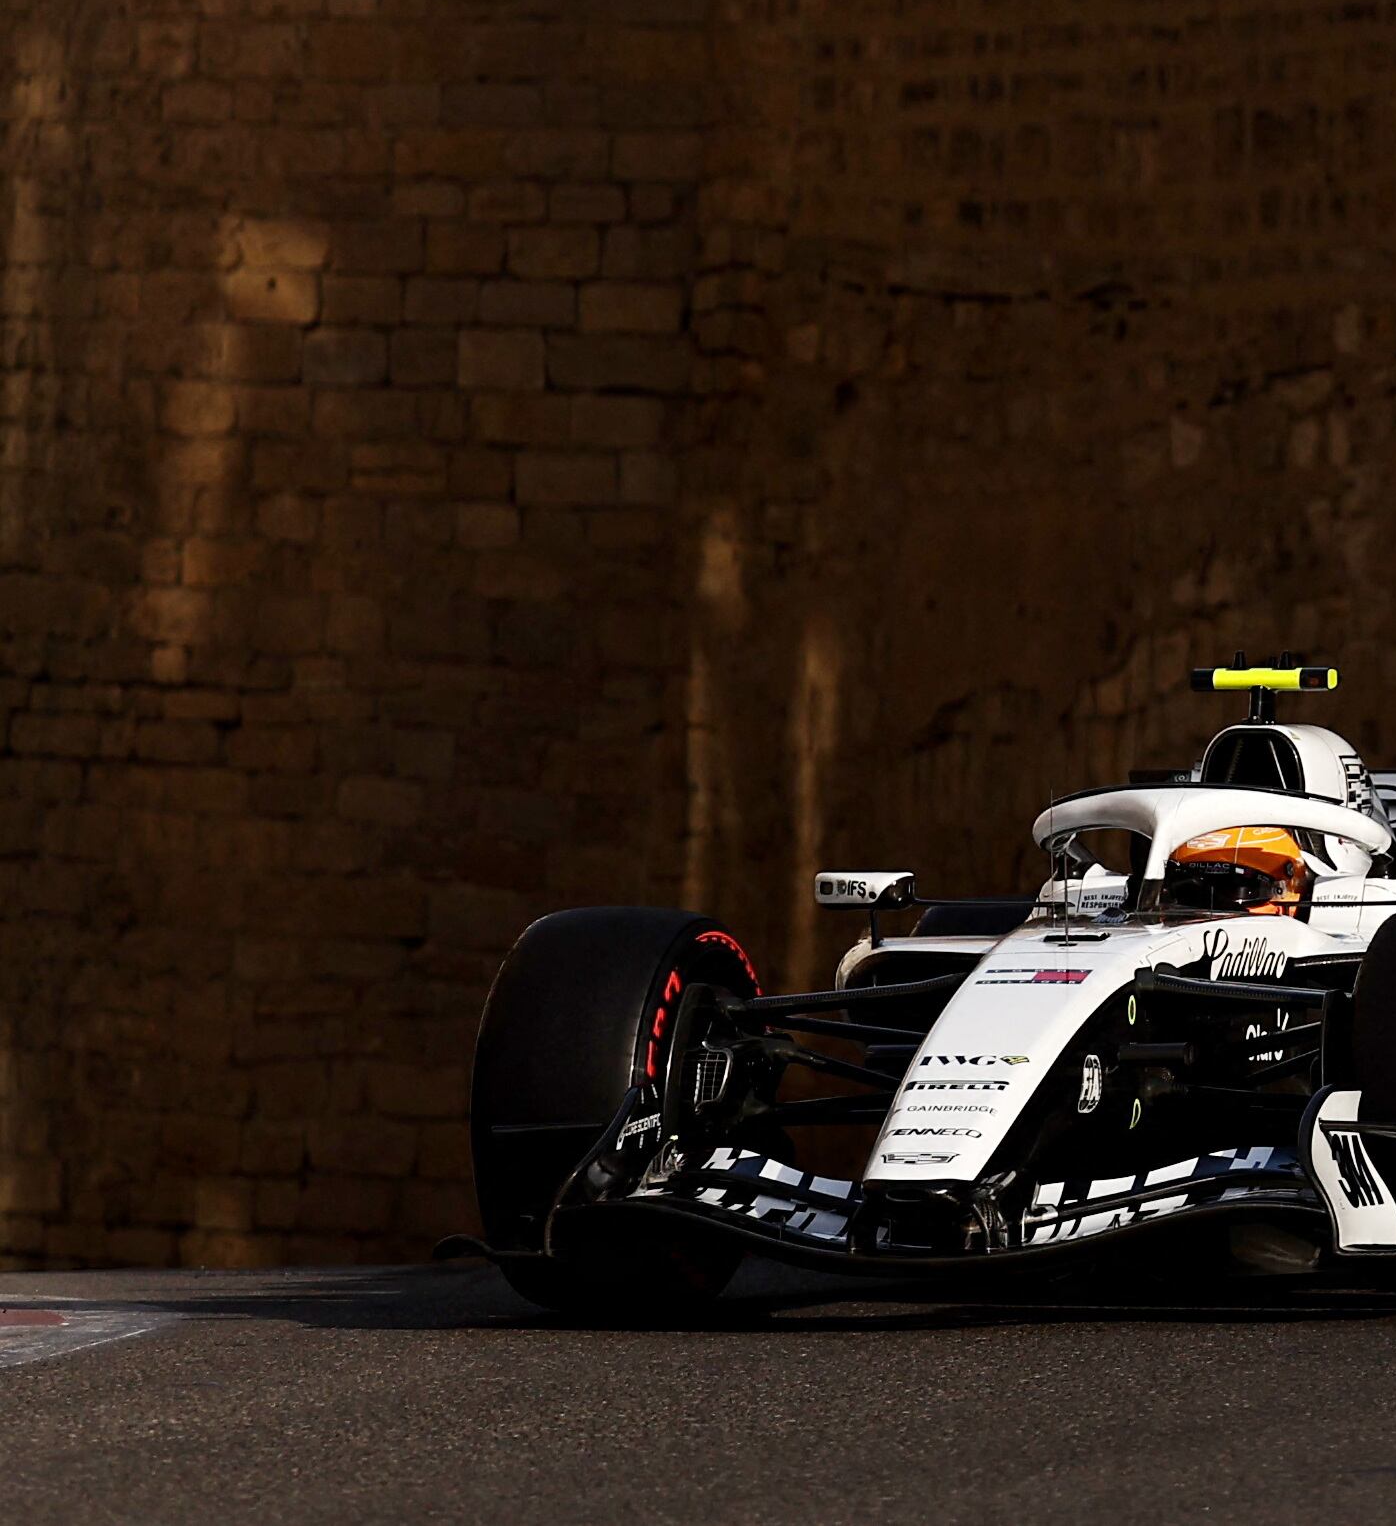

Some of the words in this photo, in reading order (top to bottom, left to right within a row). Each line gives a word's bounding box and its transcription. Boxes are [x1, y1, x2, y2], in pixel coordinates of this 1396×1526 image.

[847, 880, 867, 898] IFS
[1203, 928, 1286, 981] Cadillac
[903, 1079, 1010, 1092] PIRELLI
[907, 1105, 998, 1115] GAINBRIDGE
[884, 1128, 982, 1139] TENNECO
[1331, 1133, 1384, 1209] 3M
